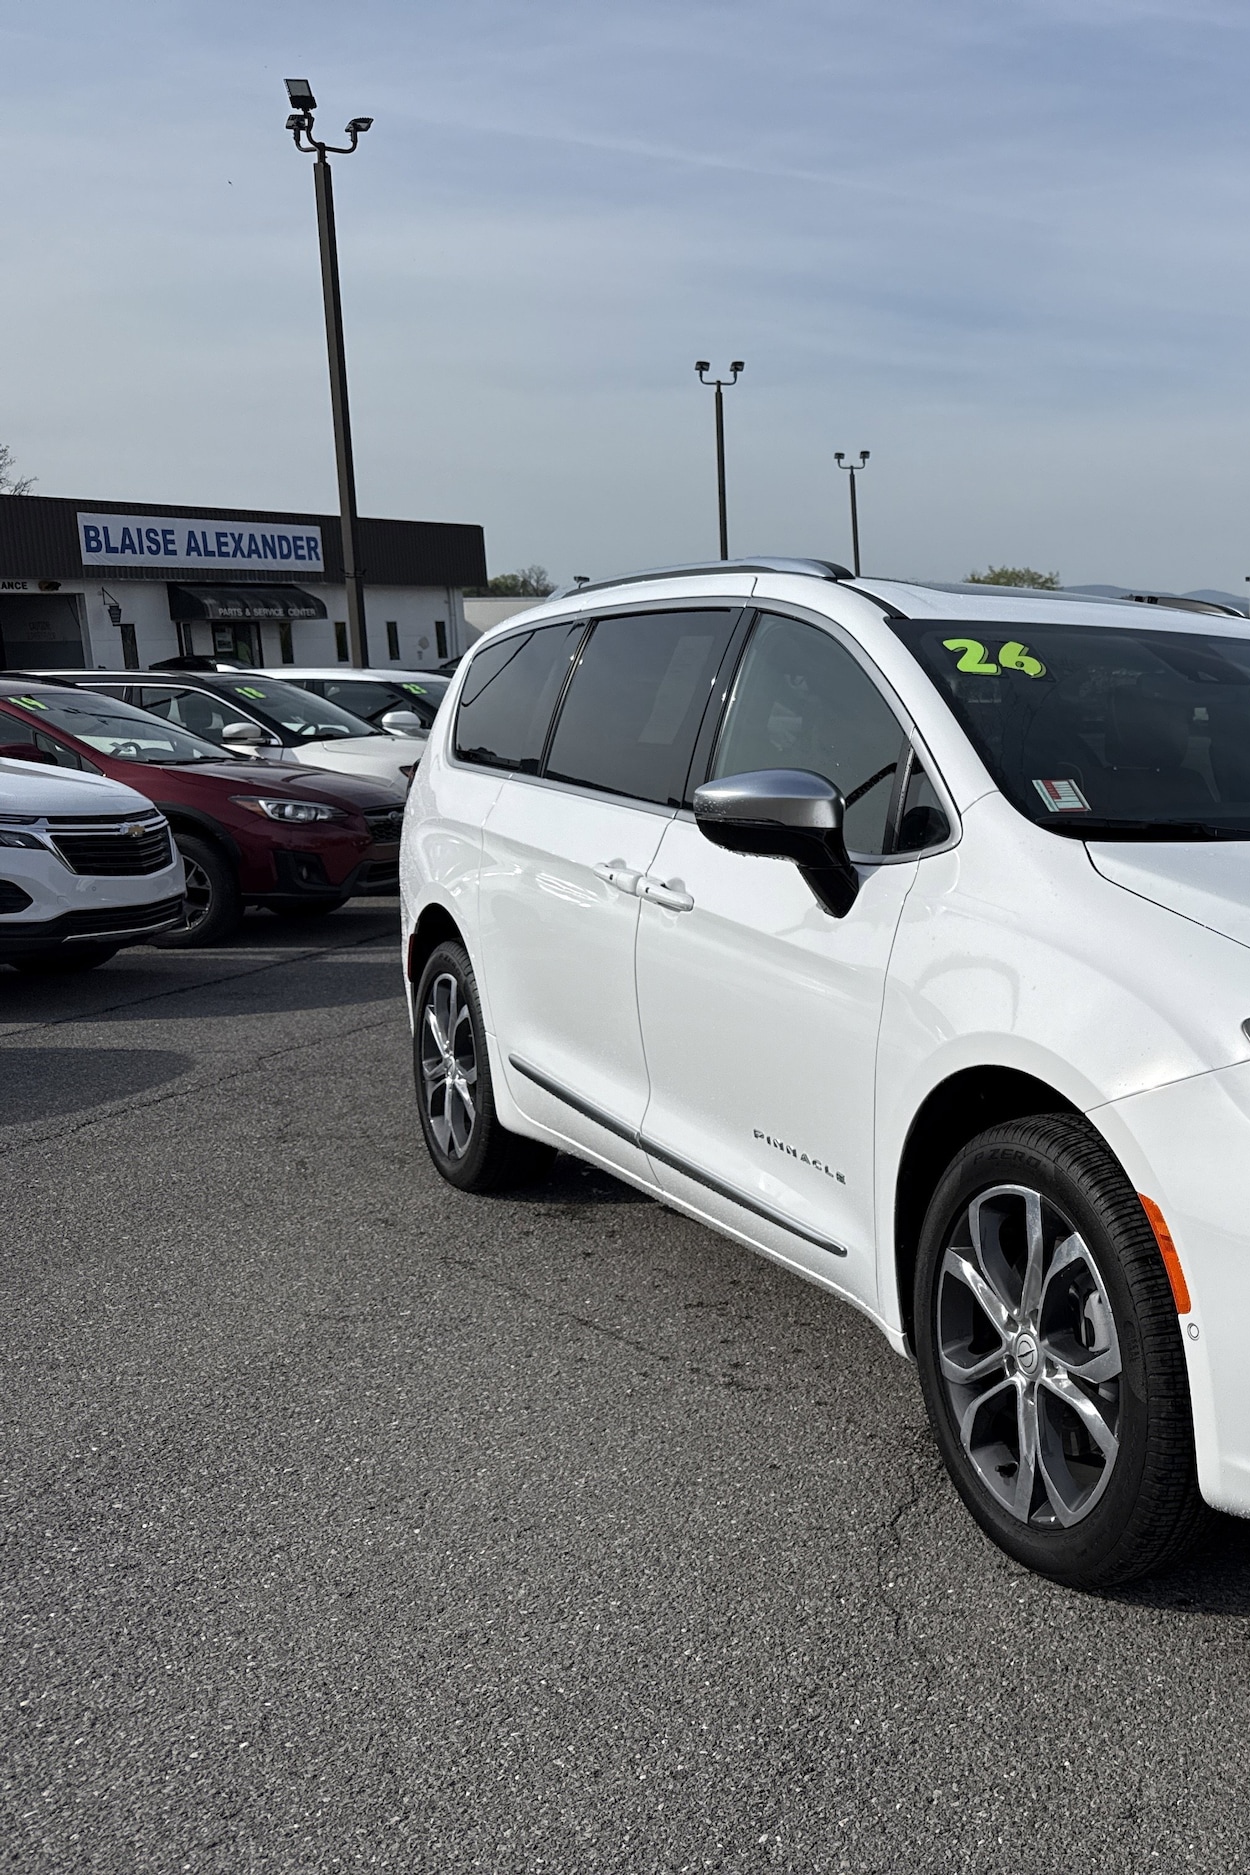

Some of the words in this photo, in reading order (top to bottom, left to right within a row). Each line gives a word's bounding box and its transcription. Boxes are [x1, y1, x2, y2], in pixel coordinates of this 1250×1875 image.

[83, 525, 178, 556] BLAISE
[185, 530, 321, 561] ALEXANDER
[1, 581, 28, 590] ANCE
[218, 607, 243, 617] PARTS
[245, 608, 251, 617] &
[253, 608, 285, 617] SERVICE
[287, 608, 316, 617] CENTER
[942, 638, 1047, 678] 26
[8, 696, 49, 711] 19
[753, 1129, 847, 1186] PINNACLE
[973, 1151, 985, 1166] P
[989, 1148, 1042, 1170] ZERO
